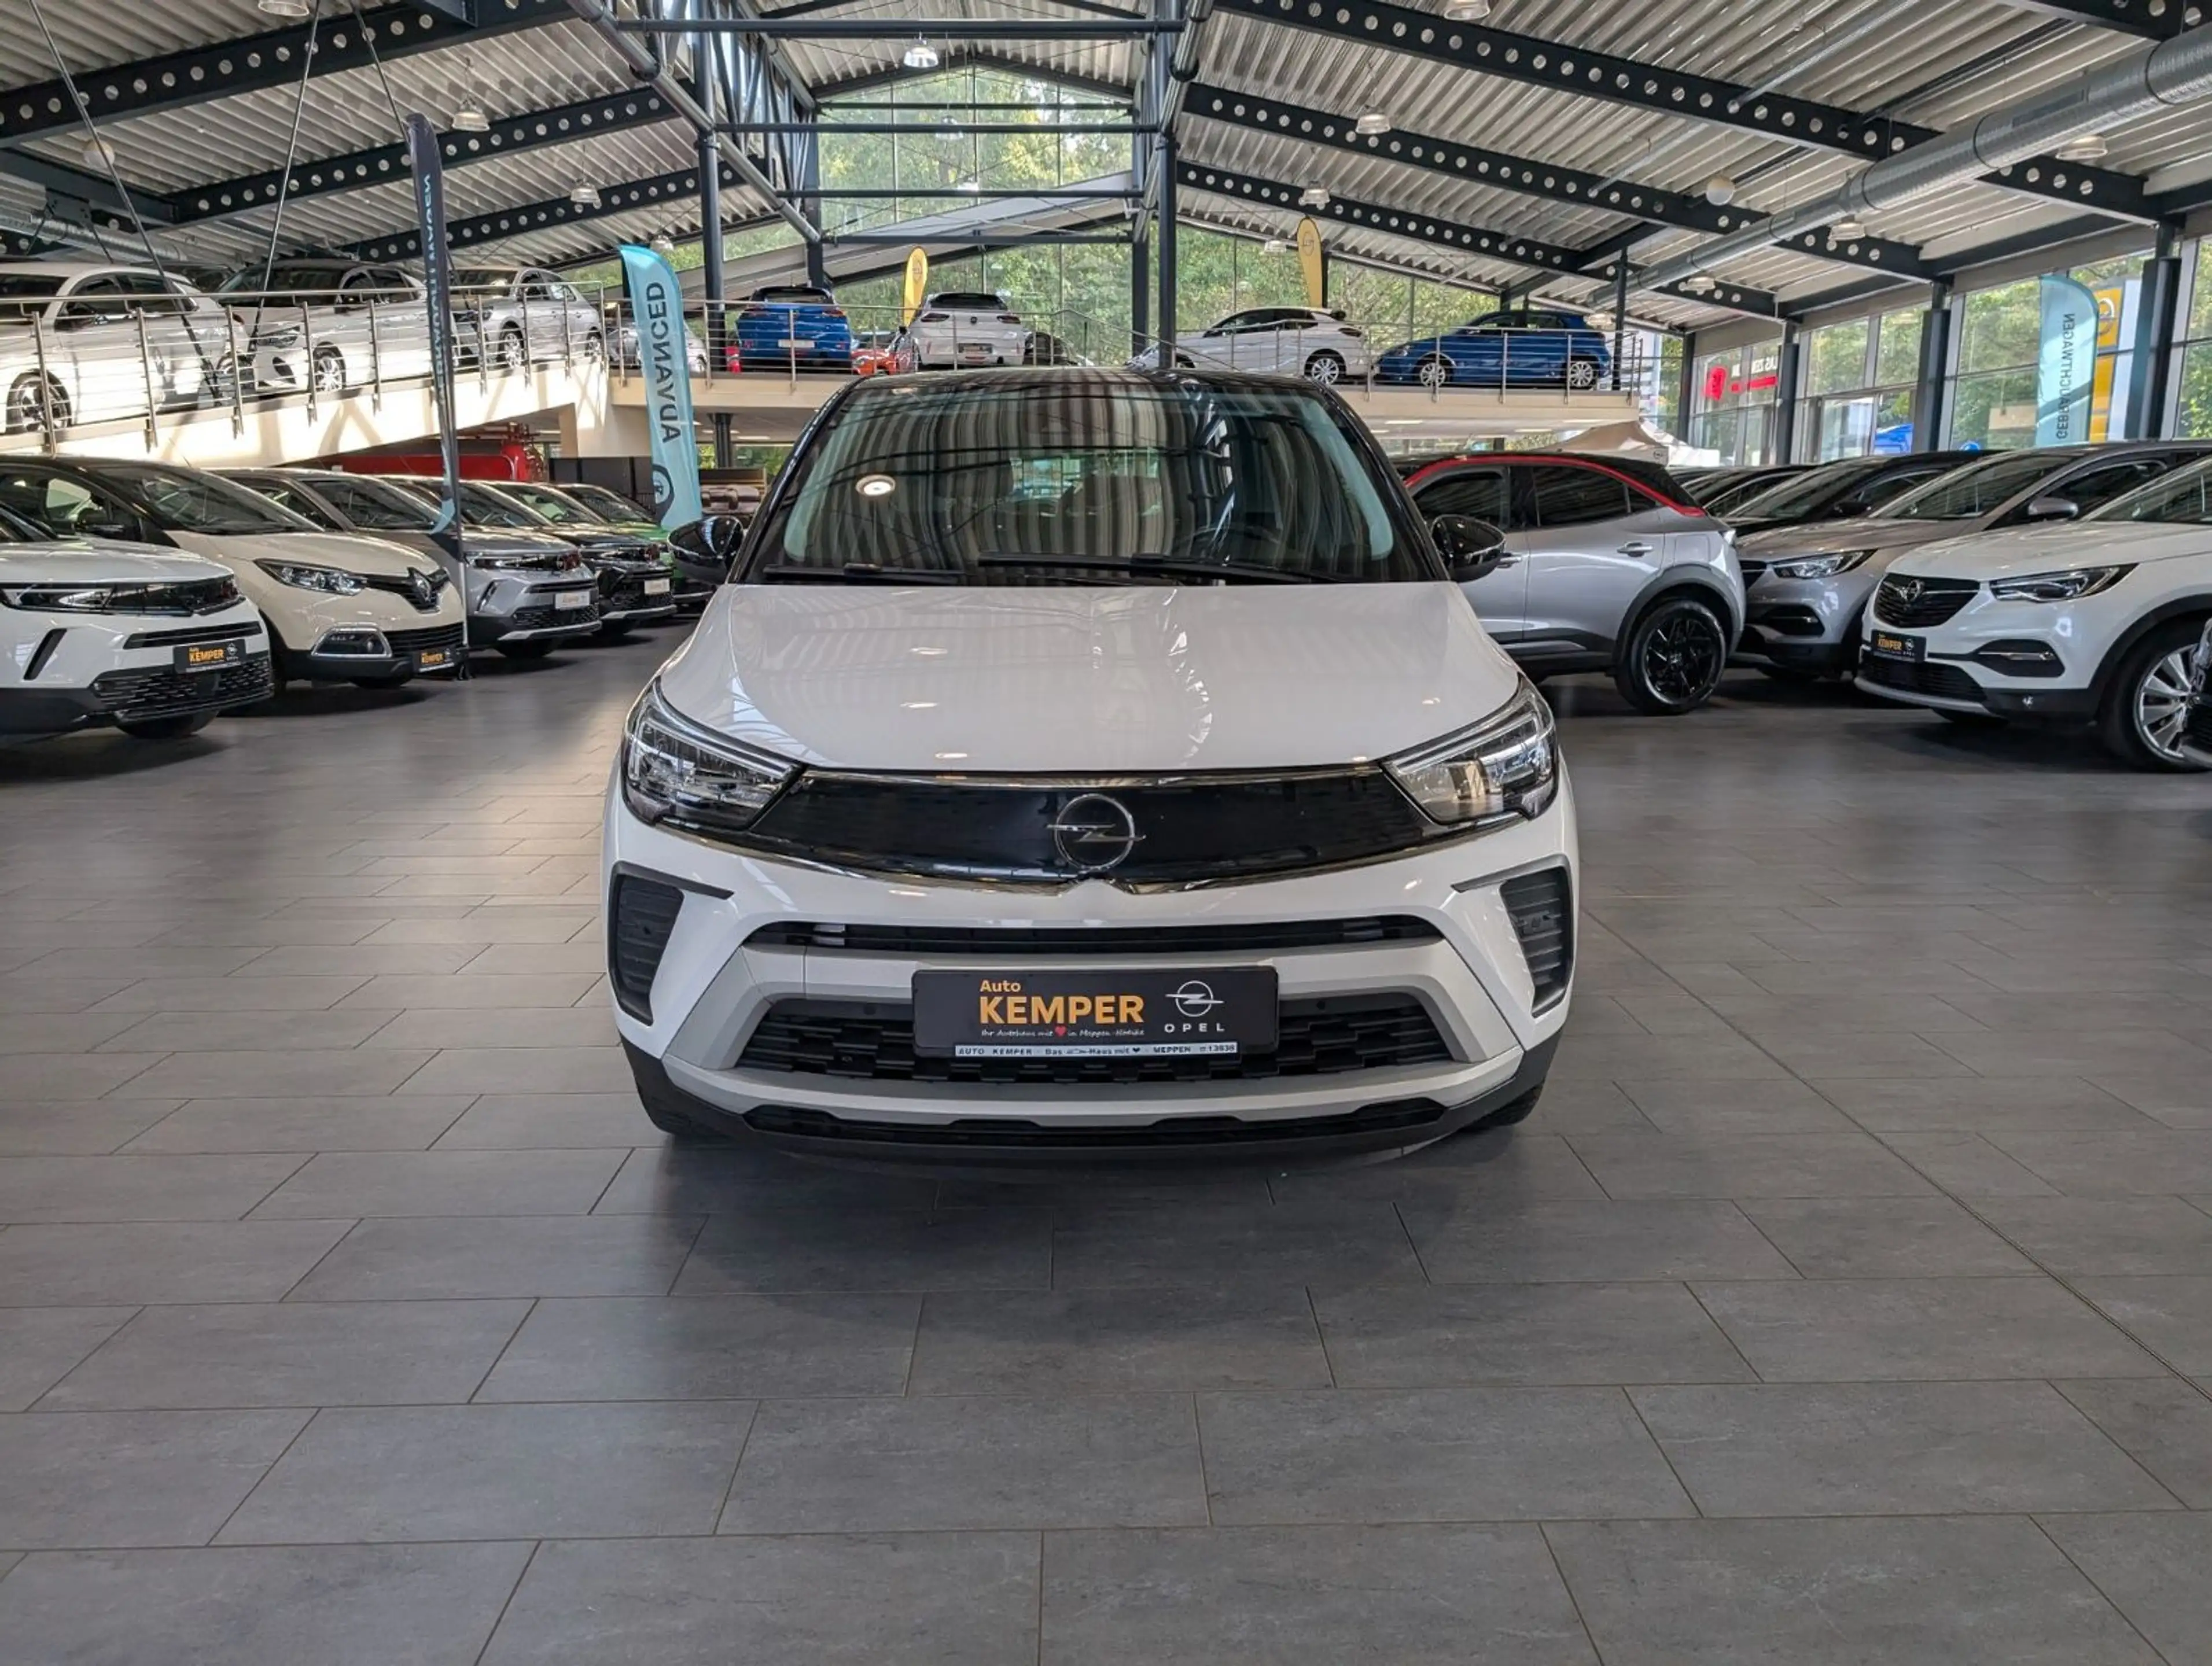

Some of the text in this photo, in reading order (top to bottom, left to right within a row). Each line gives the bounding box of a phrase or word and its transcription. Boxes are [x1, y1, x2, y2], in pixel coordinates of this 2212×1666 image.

[980, 980, 1021, 992] Auto
[980, 995, 1144, 1024] KEMPER
[1164, 1022, 1225, 1033] OPEL
